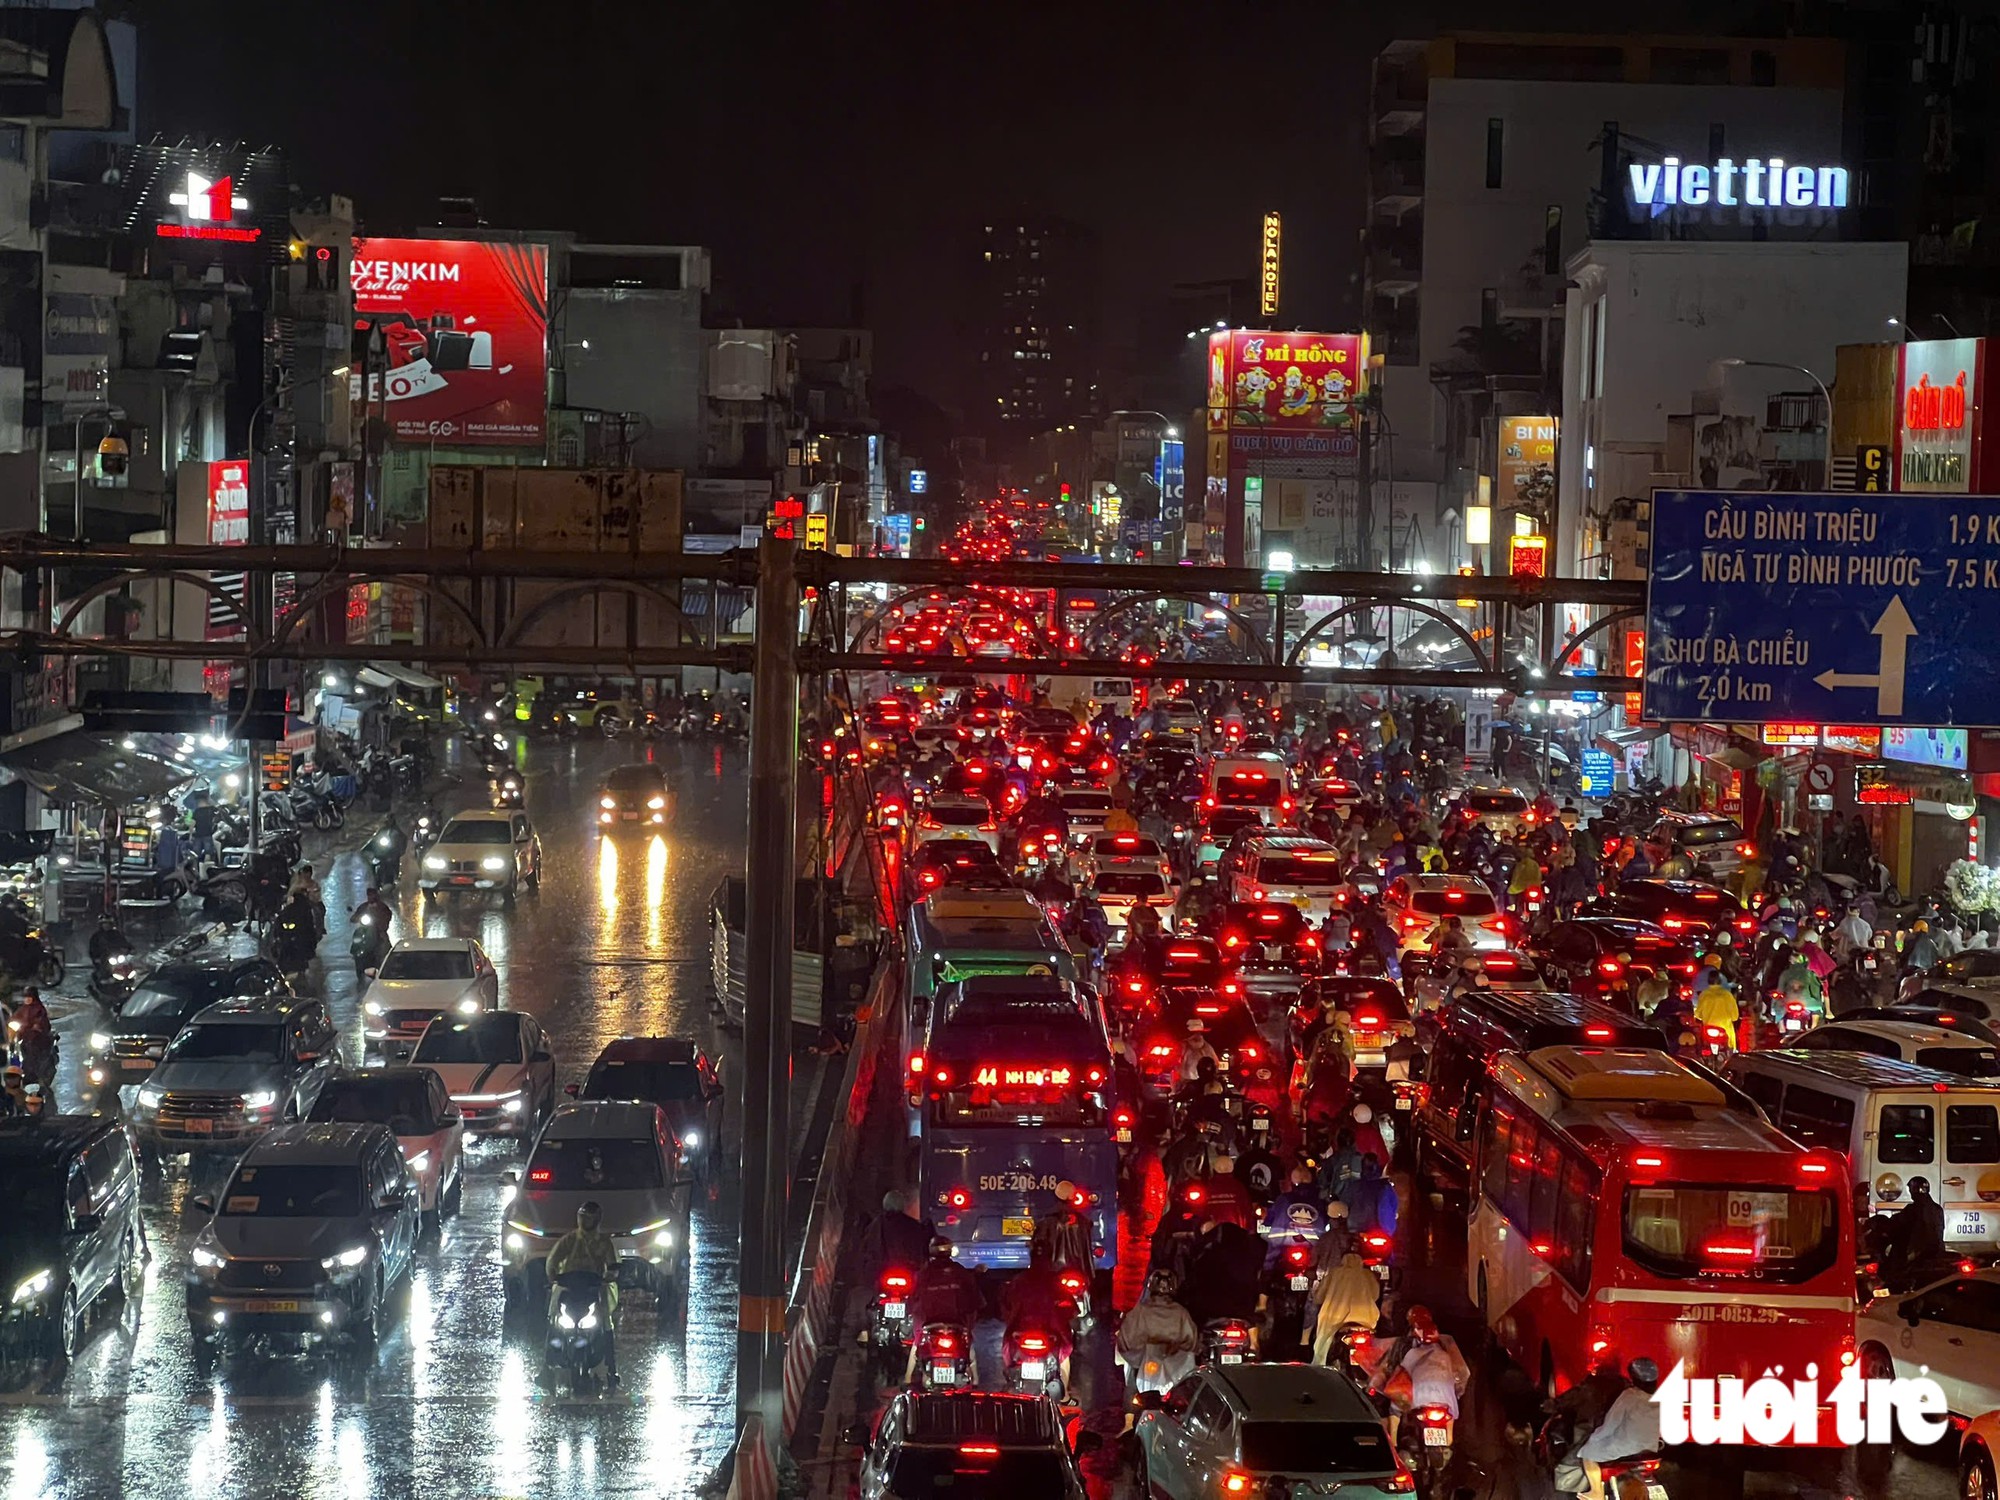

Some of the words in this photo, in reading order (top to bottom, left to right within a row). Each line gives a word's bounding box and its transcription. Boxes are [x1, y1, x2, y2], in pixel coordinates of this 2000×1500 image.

[1629, 157, 1848, 206] viettien
[1265, 217, 1278, 258] NOLA
[1264, 261, 1277, 312] HOTEL
[1294, 343, 1347, 363] HỒNG
[1705, 499, 1746, 540] CẦU
[1754, 504, 1805, 540] BÌNH
[1814, 507, 1877, 547] TRIỆU
[1949, 514, 1980, 546] 1,9
[1701, 549, 1746, 583] NGÃ
[1753, 552, 1781, 583] TƯ
[1788, 548, 1840, 584] BÌNH
[1847, 549, 1922, 587] PHƯỚC
[1946, 558, 1977, 590] 7,5
[1713, 633, 1741, 666] BÀ
[1747, 628, 1809, 666] CHIỂU
[1697, 675, 1731, 704] 2,0
[1737, 676, 1772, 702] km
[977, 1068, 998, 1086] 44
[1006, 1071, 1024, 1084] NH
[532, 1172, 549, 1180] TAXI
[980, 1175, 1057, 1191] 50E-206.48
[1730, 1200, 1752, 1218] 09
[1963, 1212, 1980, 1222] 75D
[1956, 1224, 1986, 1234] 003.85
